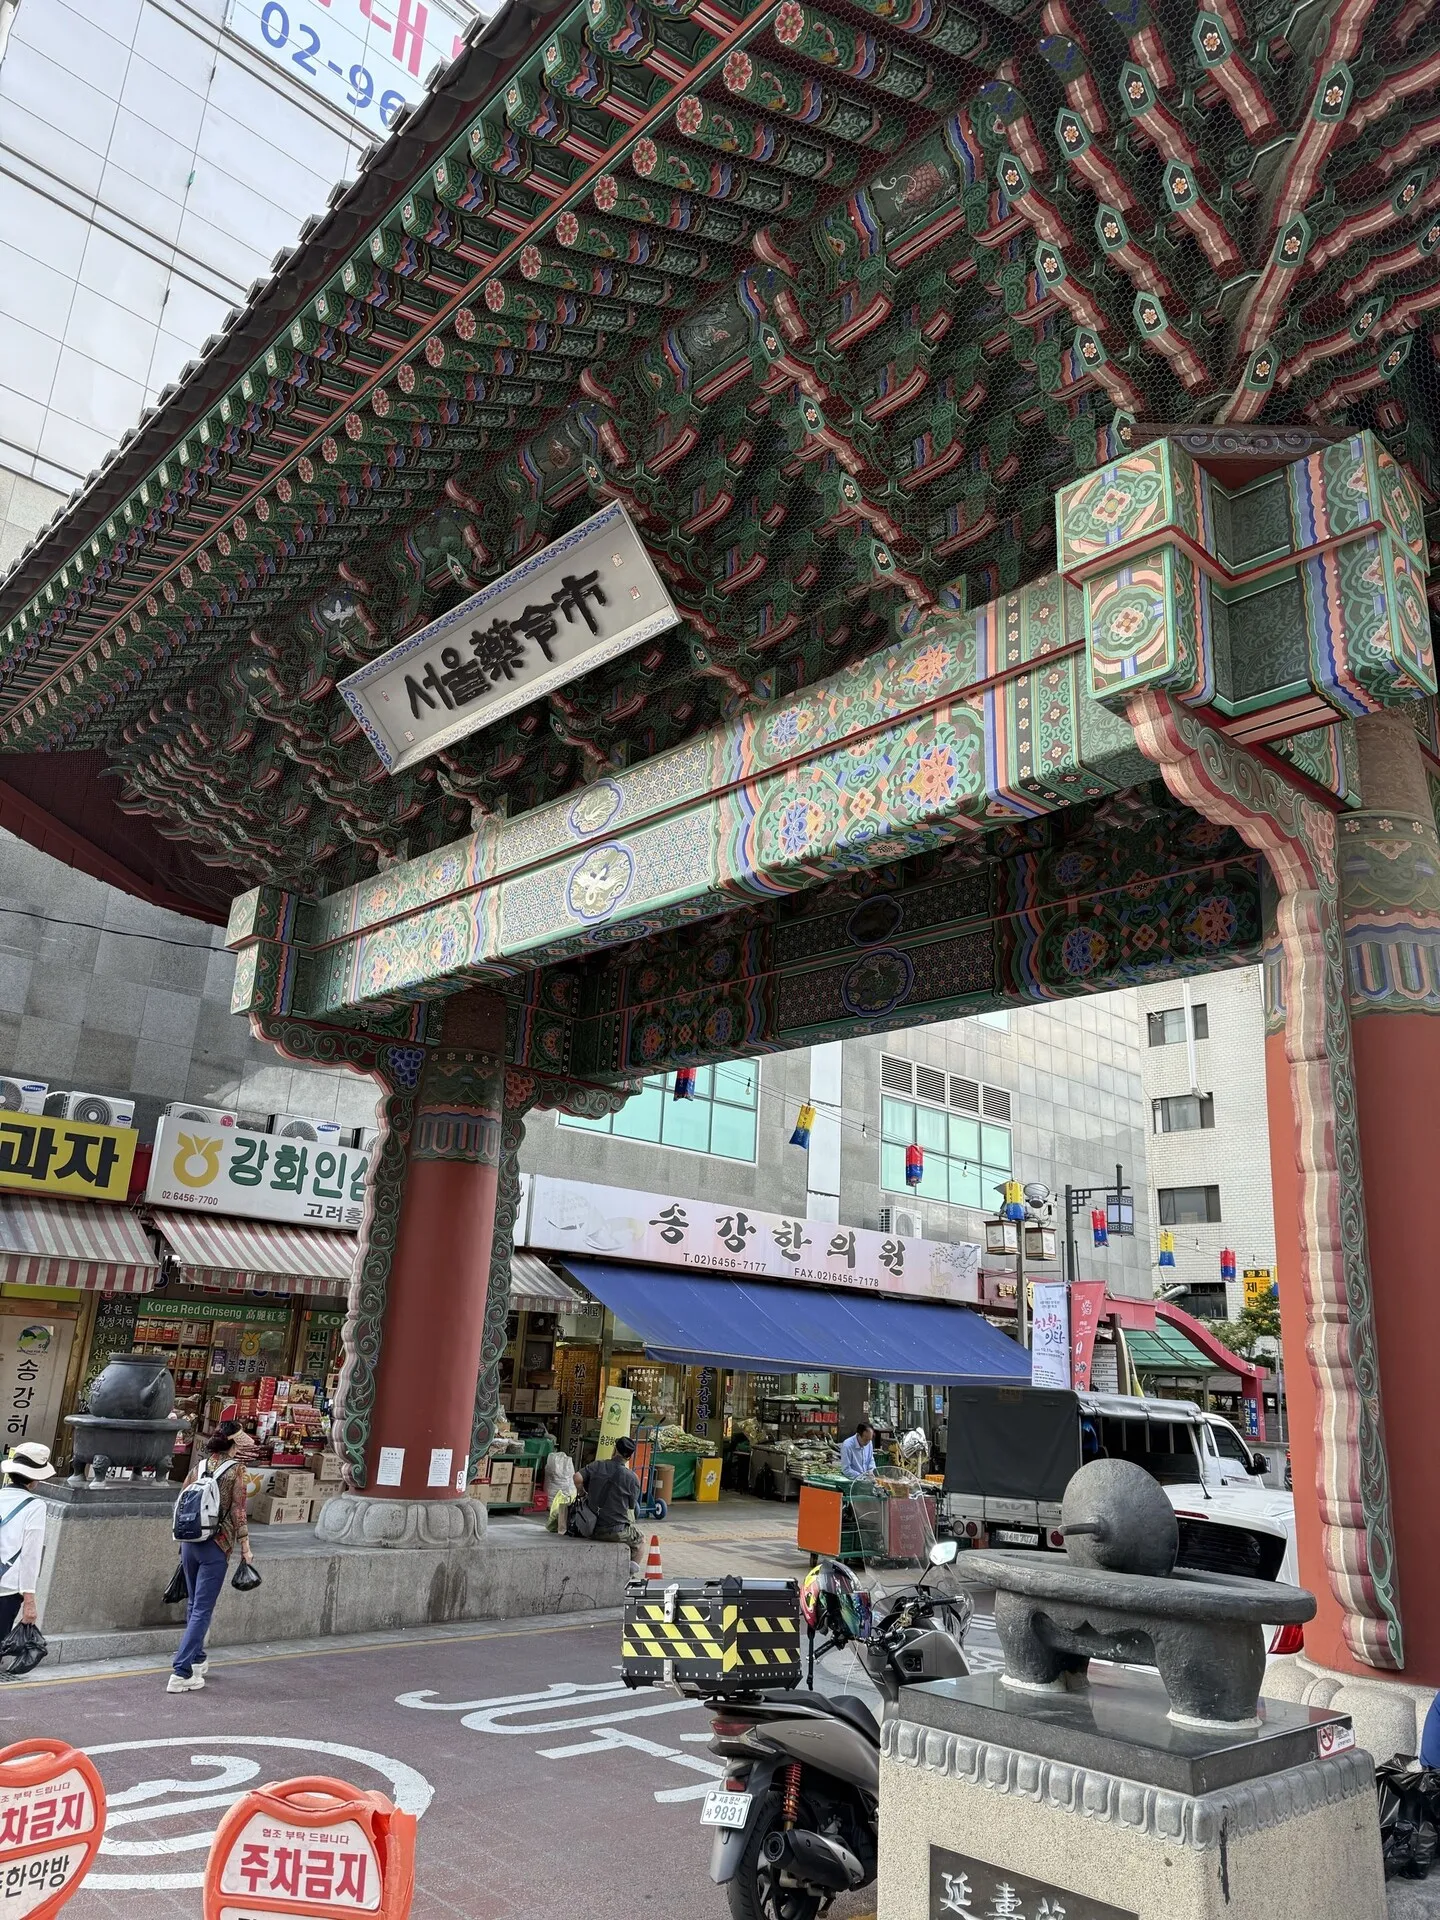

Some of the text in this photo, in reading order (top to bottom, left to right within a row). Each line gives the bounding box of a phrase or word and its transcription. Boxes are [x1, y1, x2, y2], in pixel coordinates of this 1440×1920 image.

[0, 1122, 120, 1188] 과자
[649, 1203, 906, 1276] 송강한의원
[683, 1252, 767, 1273] T.02)6456-7177
[794, 1267, 880, 1288] FAX.02)6456-7178
[146, 1301, 178, 1313] Korea
[180, 1304, 200, 1315] Red
[202, 1306, 242, 1319] Ginseng
[13, 1790, 32, 1801] 부탁
[34, 1781, 71, 1797] 드립니다
[713, 1804, 743, 1823] 9831
[262, 1828, 350, 1845] 협조 부탁 드립니다
[240, 1843, 368, 1903] 주차금지
